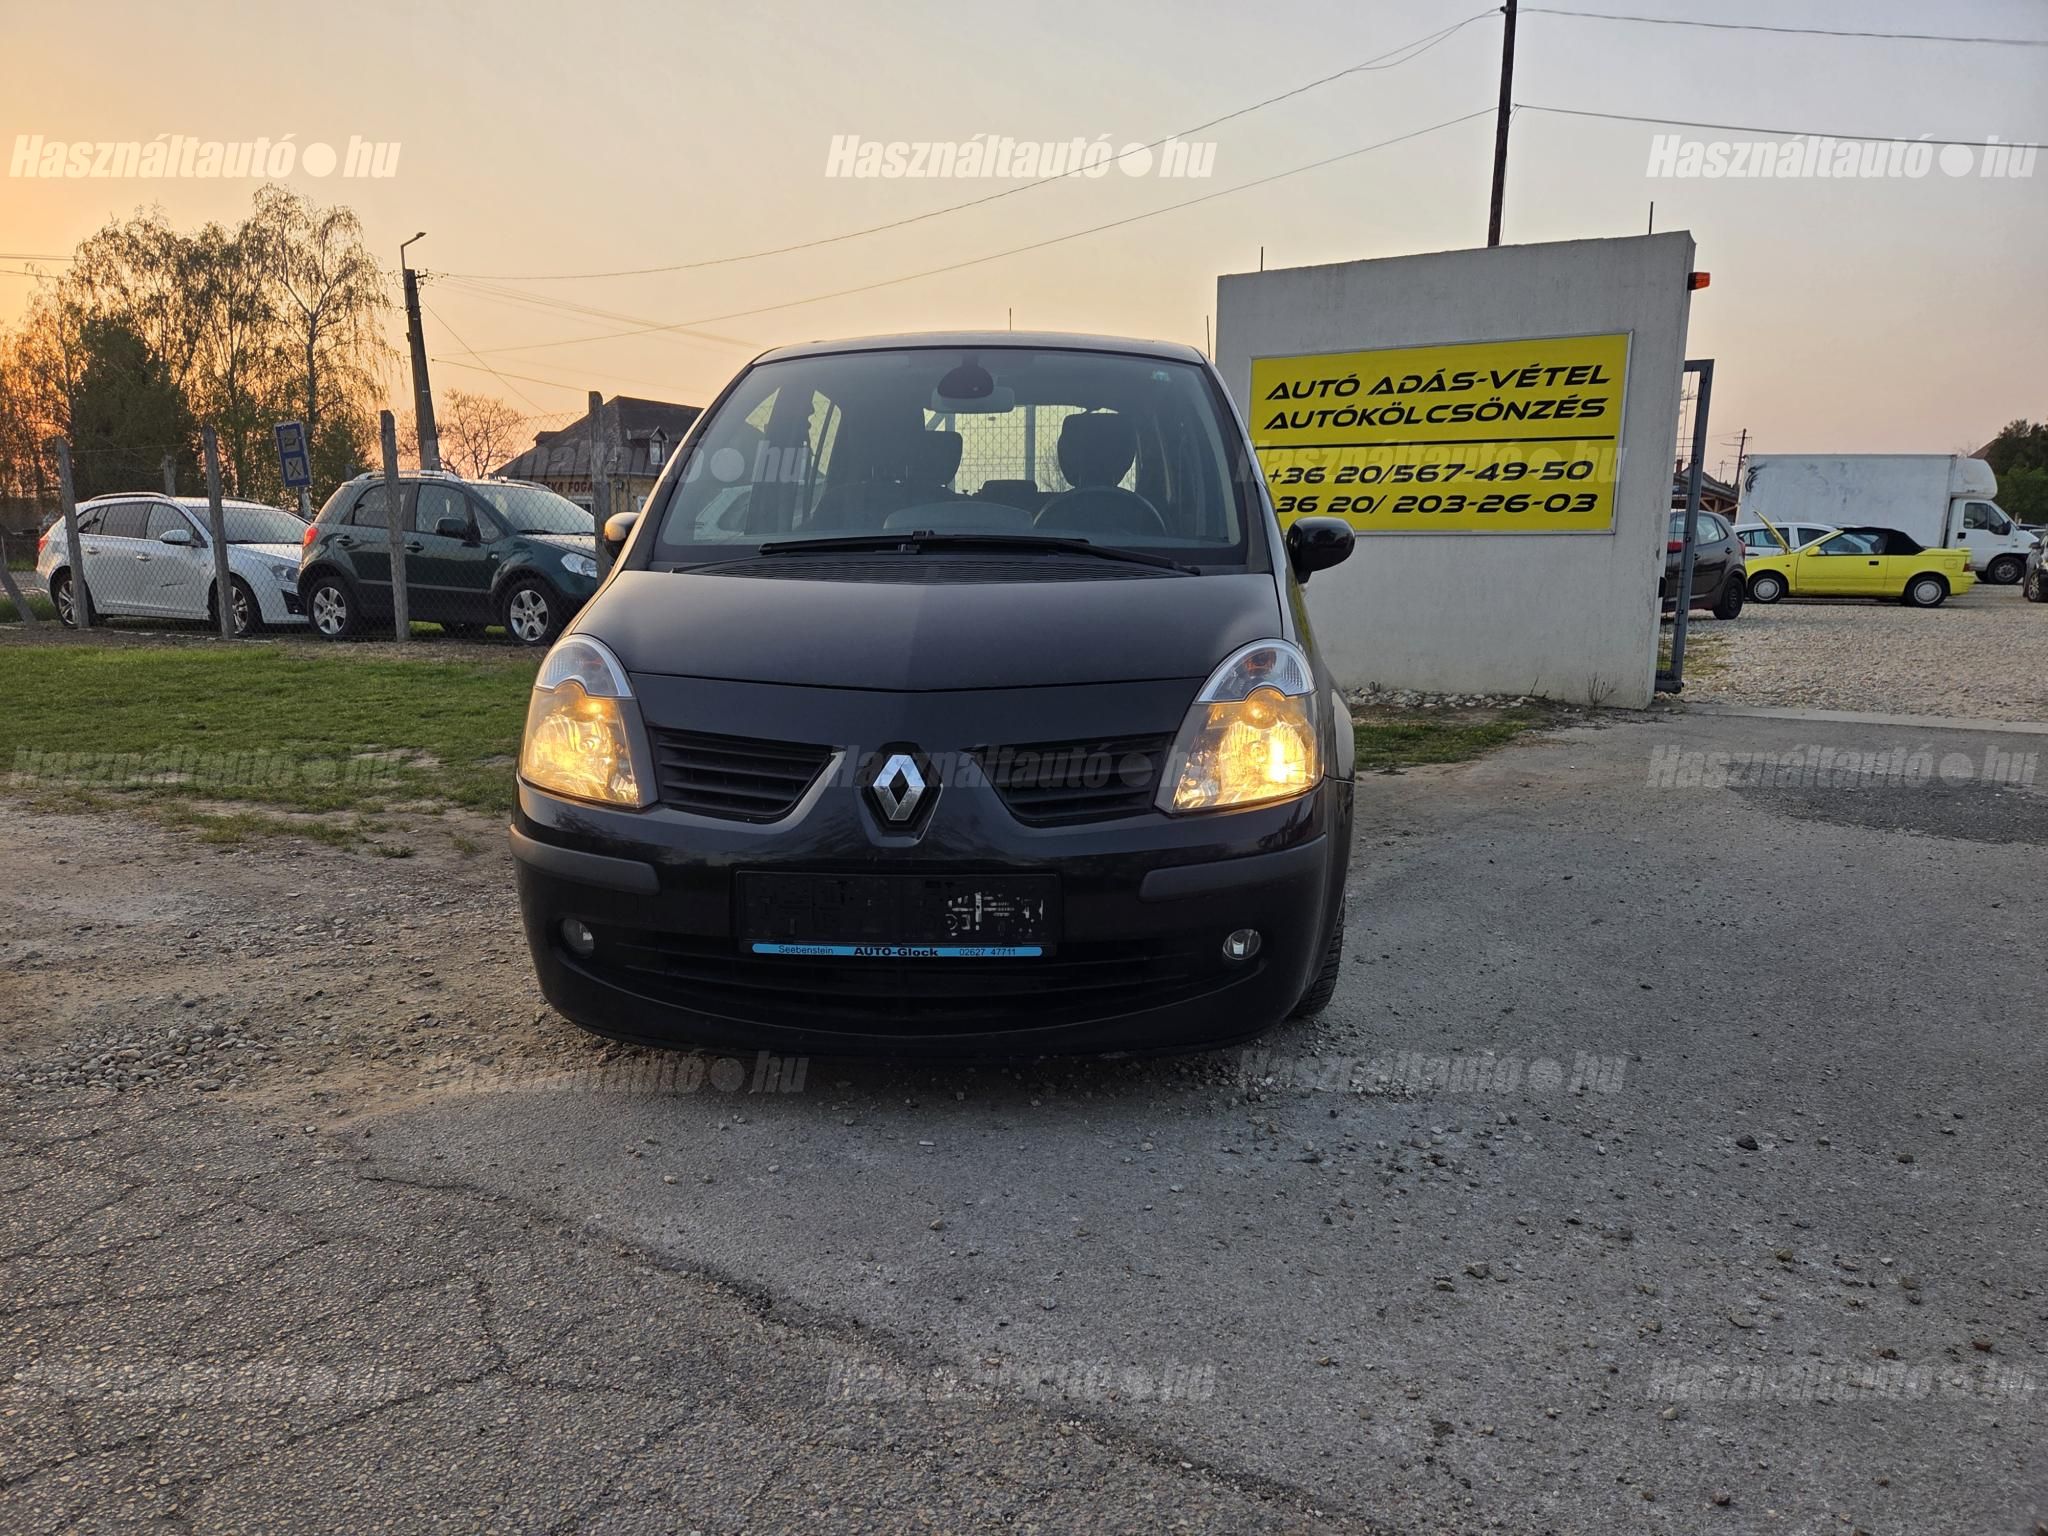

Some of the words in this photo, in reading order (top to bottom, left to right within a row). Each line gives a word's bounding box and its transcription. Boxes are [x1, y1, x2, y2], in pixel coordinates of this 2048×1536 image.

[1264, 373, 1360, 400] AUTÓ
[1367, 363, 1610, 396] ADÁS-VÉTEL
[1263, 395, 1609, 430] AUTÓKÖLCSÖNZÉS
[1269, 466, 1327, 484] +36
[1334, 461, 1594, 485] 20/567-49-50
[1277, 495, 1320, 513] 36
[1392, 494, 1598, 513] 203-26-03
[778, 944, 833, 955] Seebenstein
[854, 947, 938, 957] AUTO-Glock
